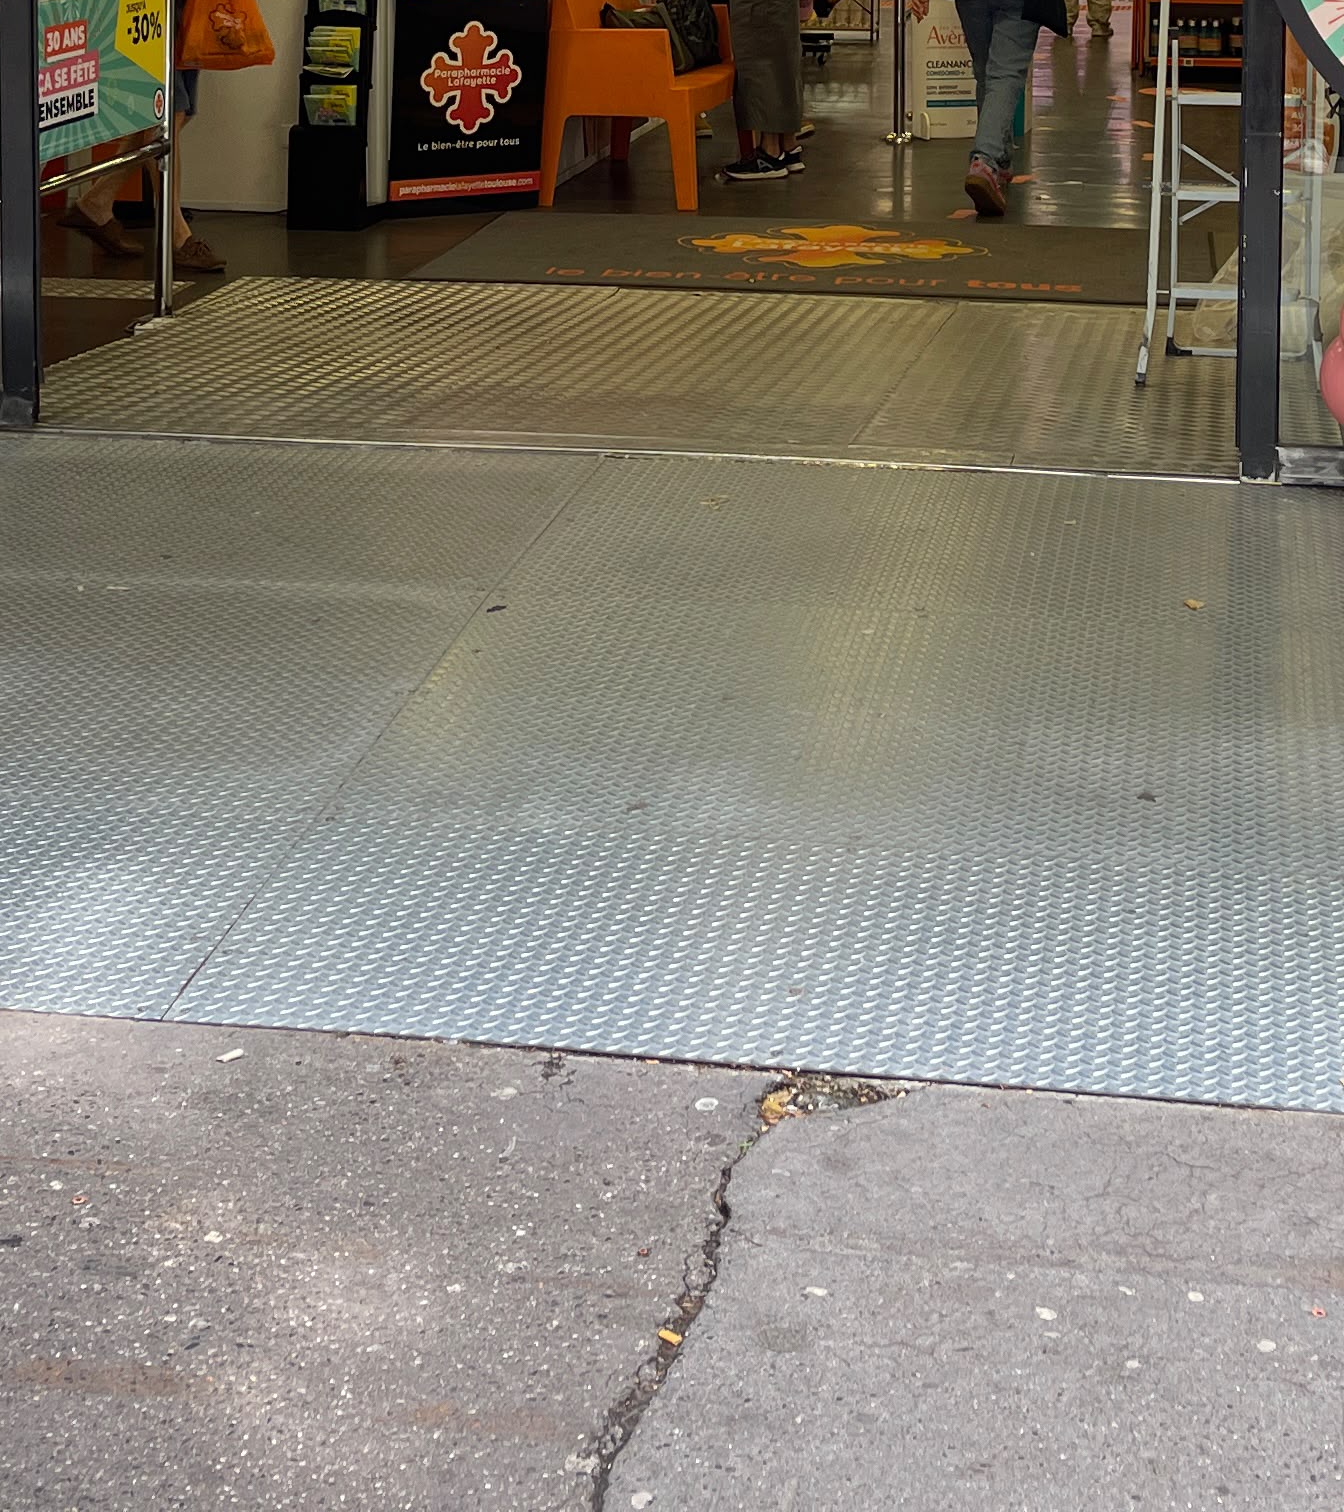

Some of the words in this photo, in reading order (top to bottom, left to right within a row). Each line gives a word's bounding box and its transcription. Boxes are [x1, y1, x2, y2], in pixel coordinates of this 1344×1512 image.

[127, 10, 162, 45] -30%
[926, 25, 967, 45] Avèn
[46, 31, 61, 53] 30
[62, 24, 86, 48] ANS
[434, 66, 511, 79] Parapharmacie
[926, 59, 973, 69] CLEANANC
[38, 71, 53, 98] ÇA
[54, 69, 68, 89] SE
[70, 59, 97, 85] FÊTE
[447, 76, 497, 88] Lafayette
[39, 88, 94, 123] ENSEMBLE
[418, 142, 429, 152] Le
[431, 140, 474, 151] bien-être
[476, 138, 498, 149] pour
[500, 137, 520, 146] tous
